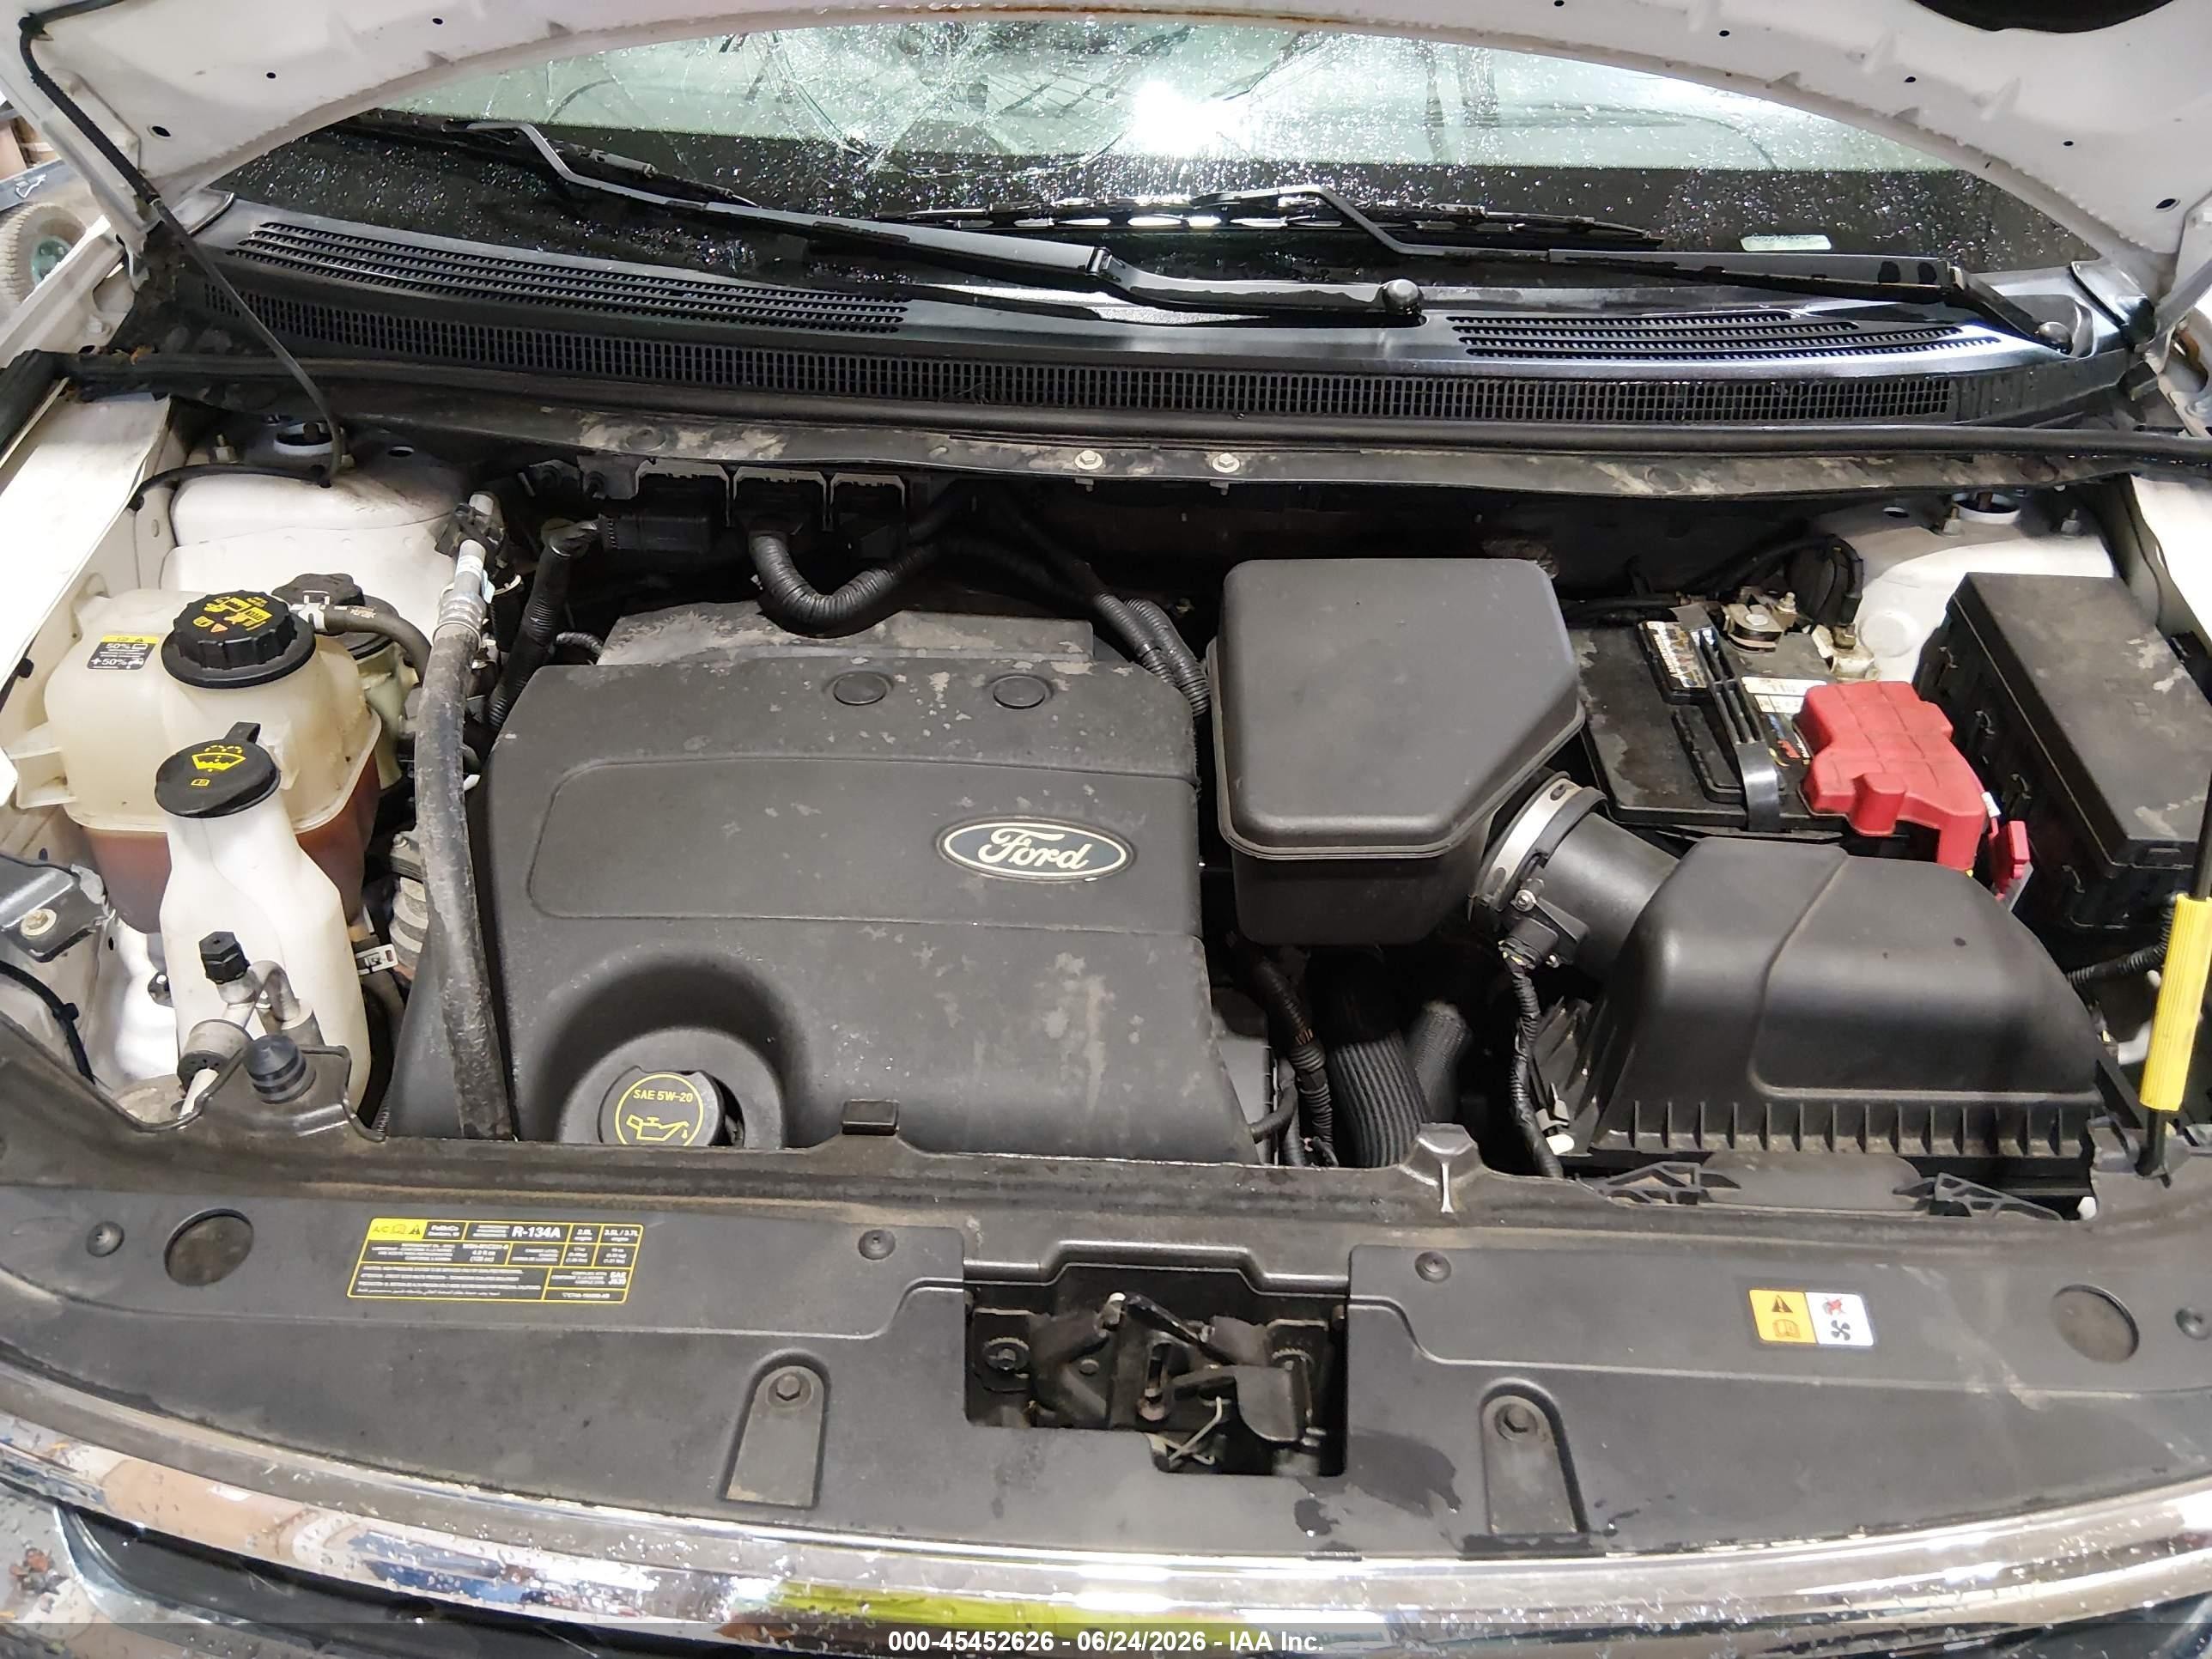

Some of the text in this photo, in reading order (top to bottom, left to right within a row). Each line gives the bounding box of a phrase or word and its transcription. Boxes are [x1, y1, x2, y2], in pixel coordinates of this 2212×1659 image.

[978, 828, 1092, 869] Ford
[633, 1089, 694, 1103] SAE 5W-20
[511, 1225, 561, 1238] R-134A
